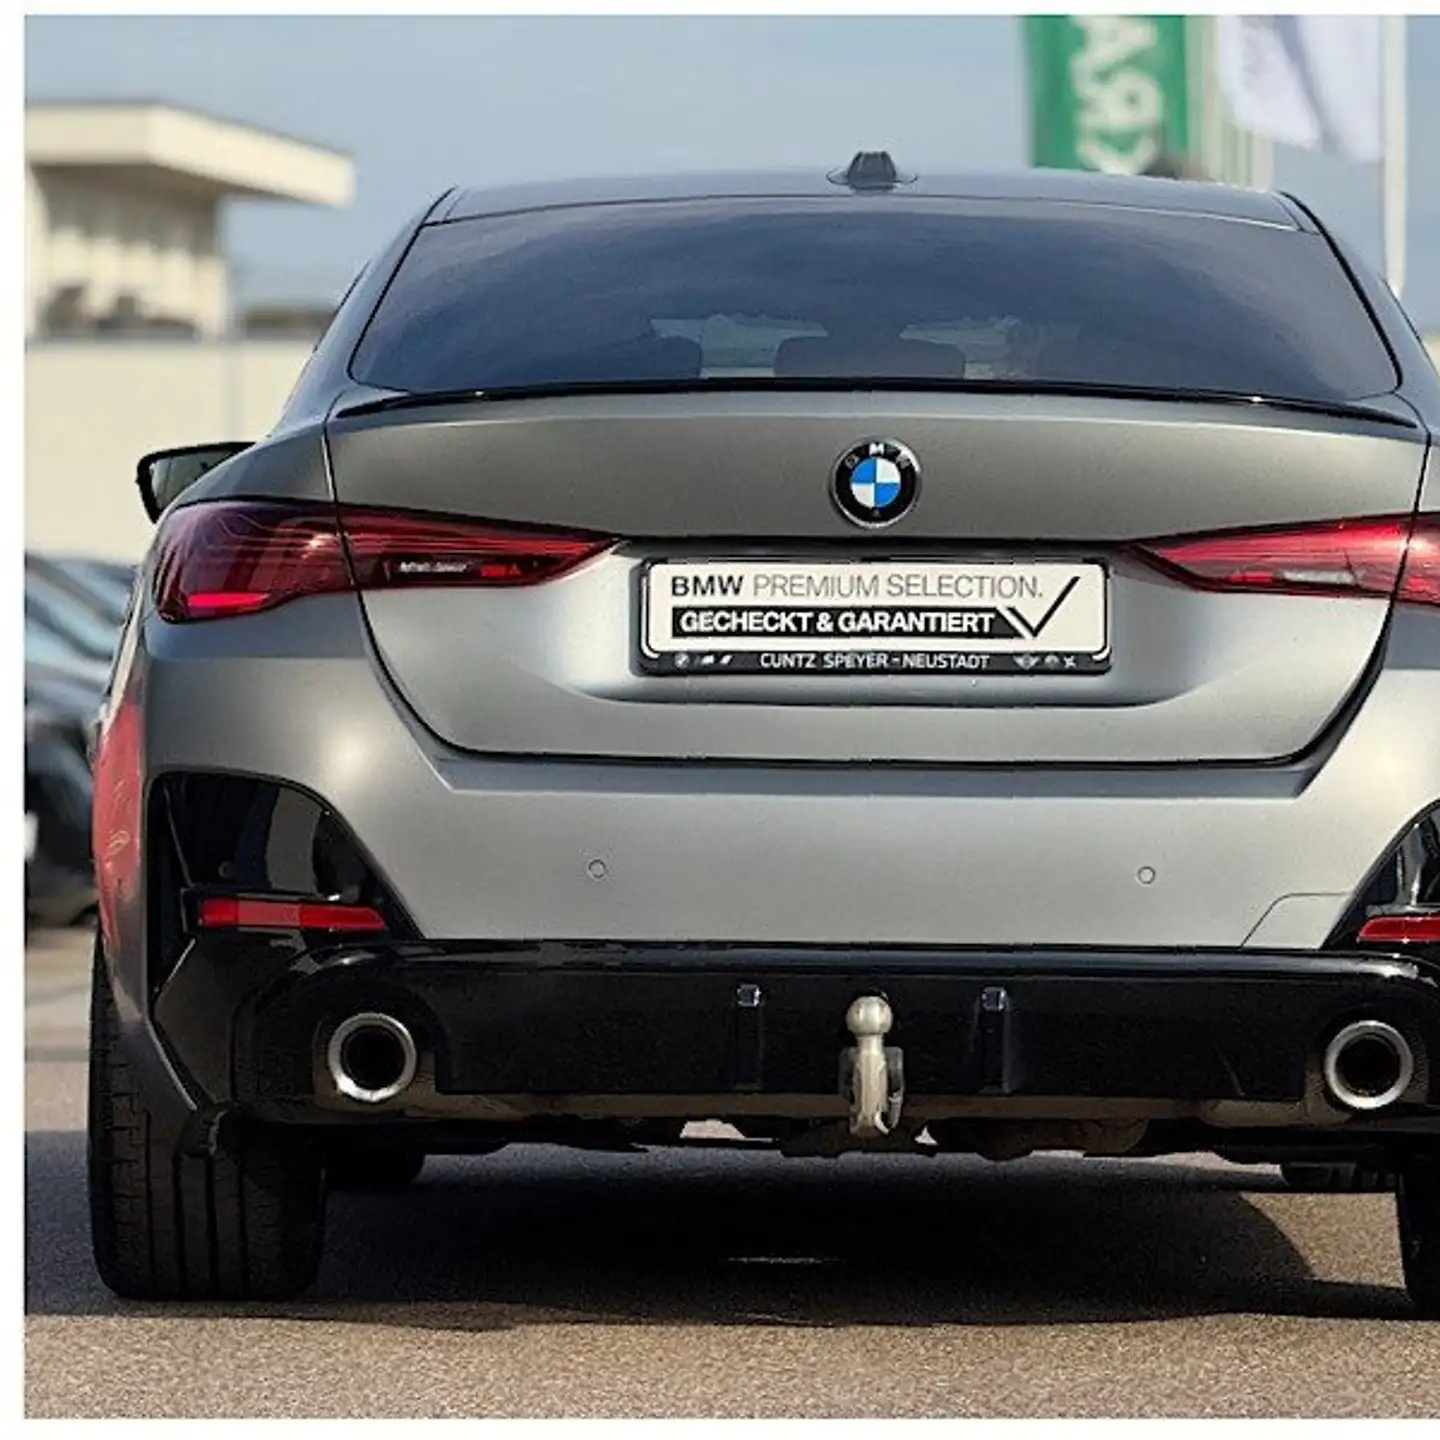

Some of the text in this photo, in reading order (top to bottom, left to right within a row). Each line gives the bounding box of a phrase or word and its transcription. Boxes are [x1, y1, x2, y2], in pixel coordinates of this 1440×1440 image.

[671, 574, 1043, 598] BMW PREMIUM SELECTION.
[680, 613, 995, 633] GECHECKT & GARANTIERT
[760, 653, 816, 669] CUNTZ
